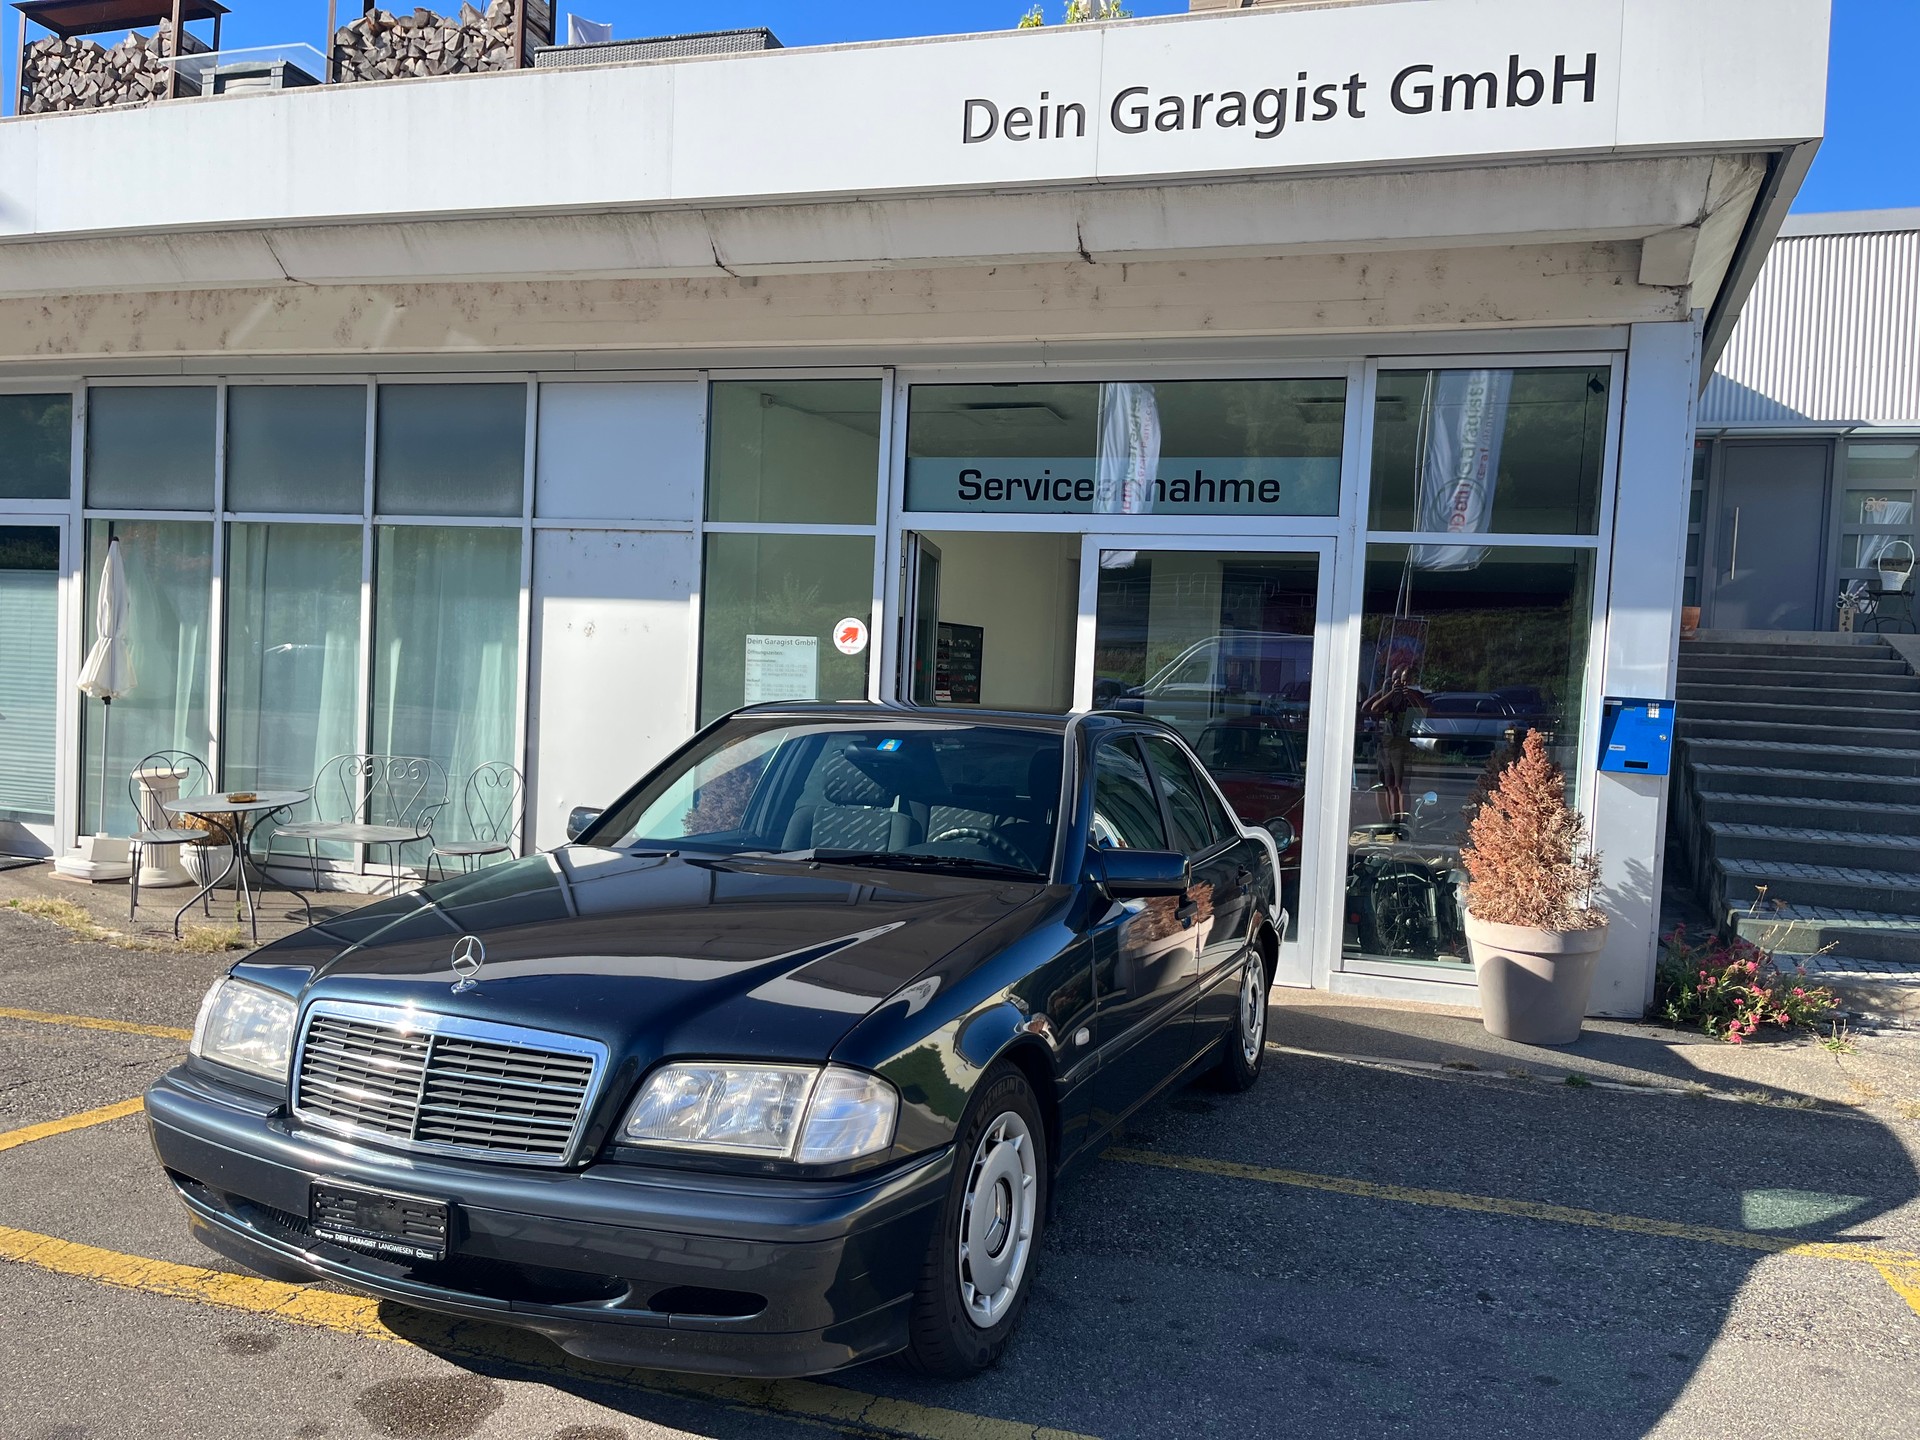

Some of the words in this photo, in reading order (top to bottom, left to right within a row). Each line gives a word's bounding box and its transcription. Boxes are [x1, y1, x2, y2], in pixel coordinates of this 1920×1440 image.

[962, 91, 1086, 144] Dein
[1109, 71, 1367, 140] Garagist
[1389, 52, 1597, 117] GmbH
[957, 469, 1280, 504] Serviceannahme
[747, 637, 763, 645] Dein
[764, 638, 793, 647] Garagist
[794, 639, 816, 647] GmbH
[335, 1233, 349, 1243] DEIN
[349, 1236, 377, 1248] GARAGIST
[378, 1243, 414, 1255] LANGWIESEN
